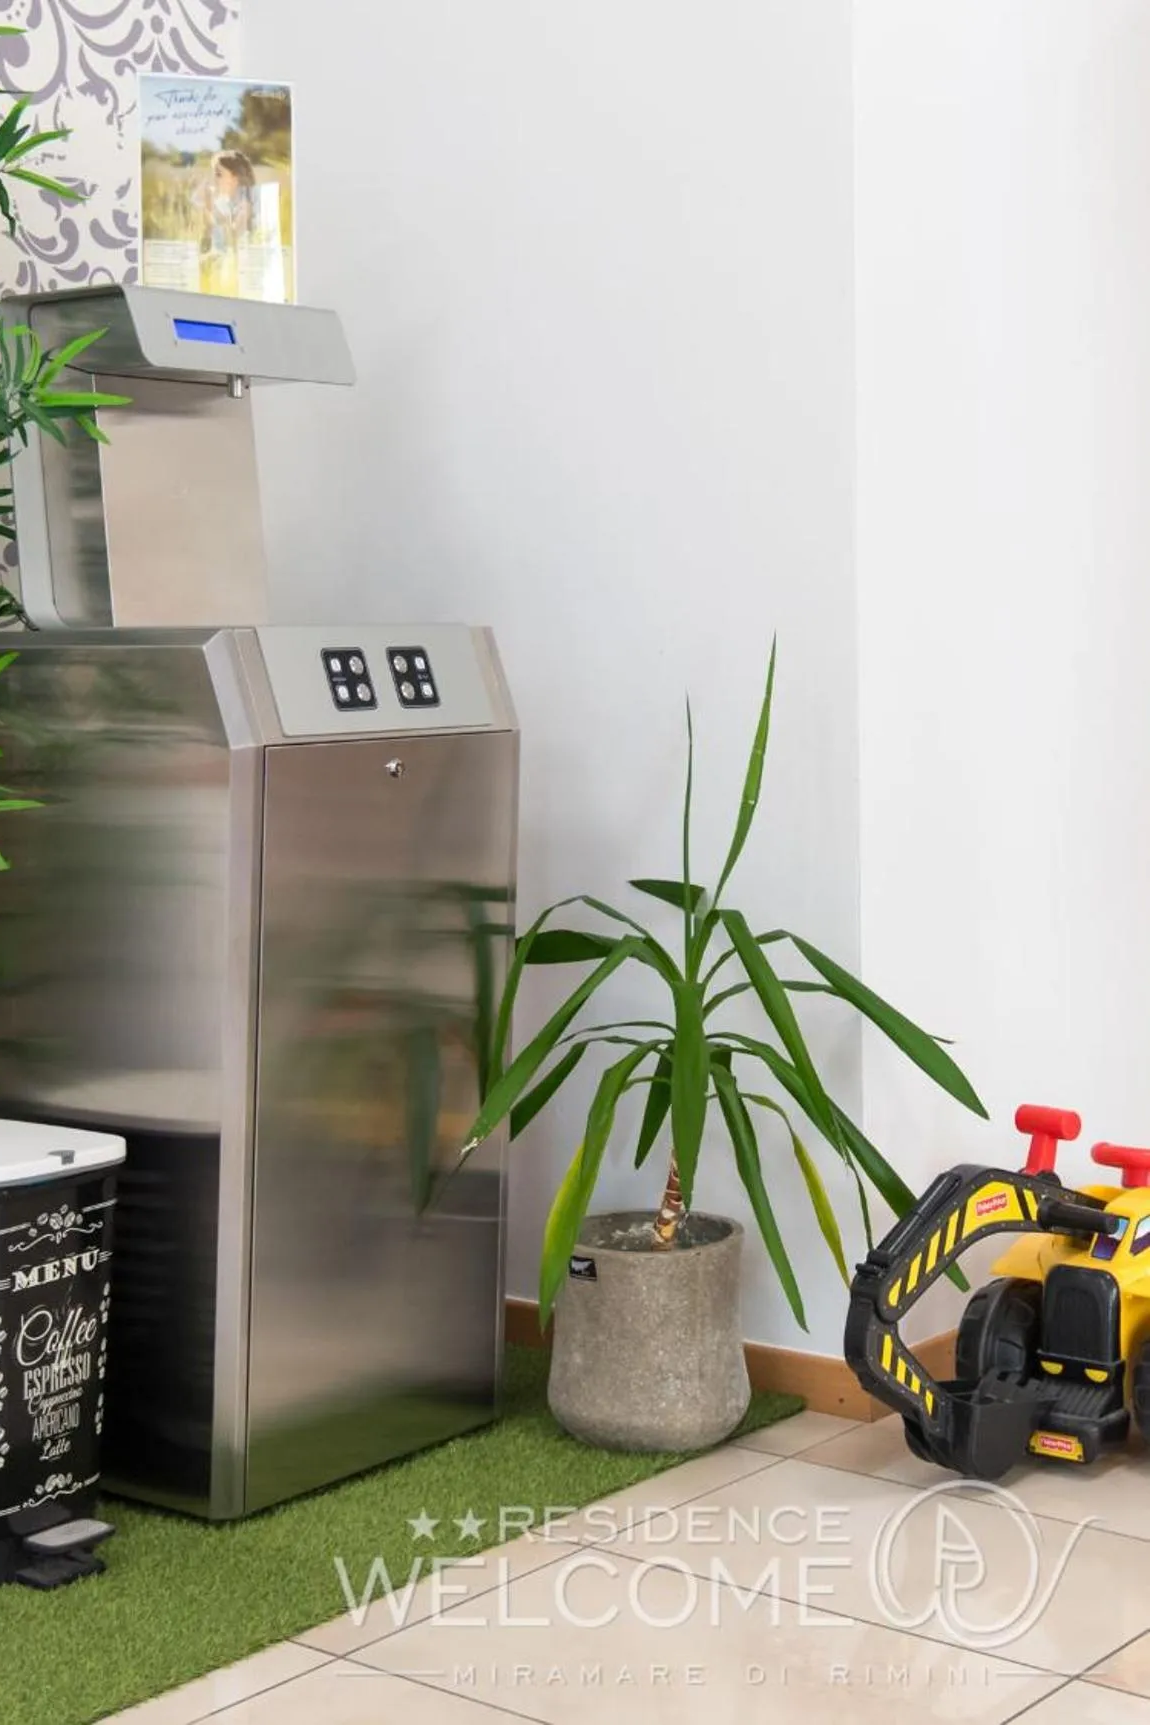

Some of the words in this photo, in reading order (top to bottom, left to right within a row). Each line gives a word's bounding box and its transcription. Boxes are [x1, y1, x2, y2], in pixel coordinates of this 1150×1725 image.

[12, 1249, 100, 1292] MENU
[16, 1307, 97, 1368] Coffee
[23, 1352, 90, 1400] ESPRESSO
[32, 1402, 80, 1441] AMERICANO
[39, 1438, 71, 1461] Latte
